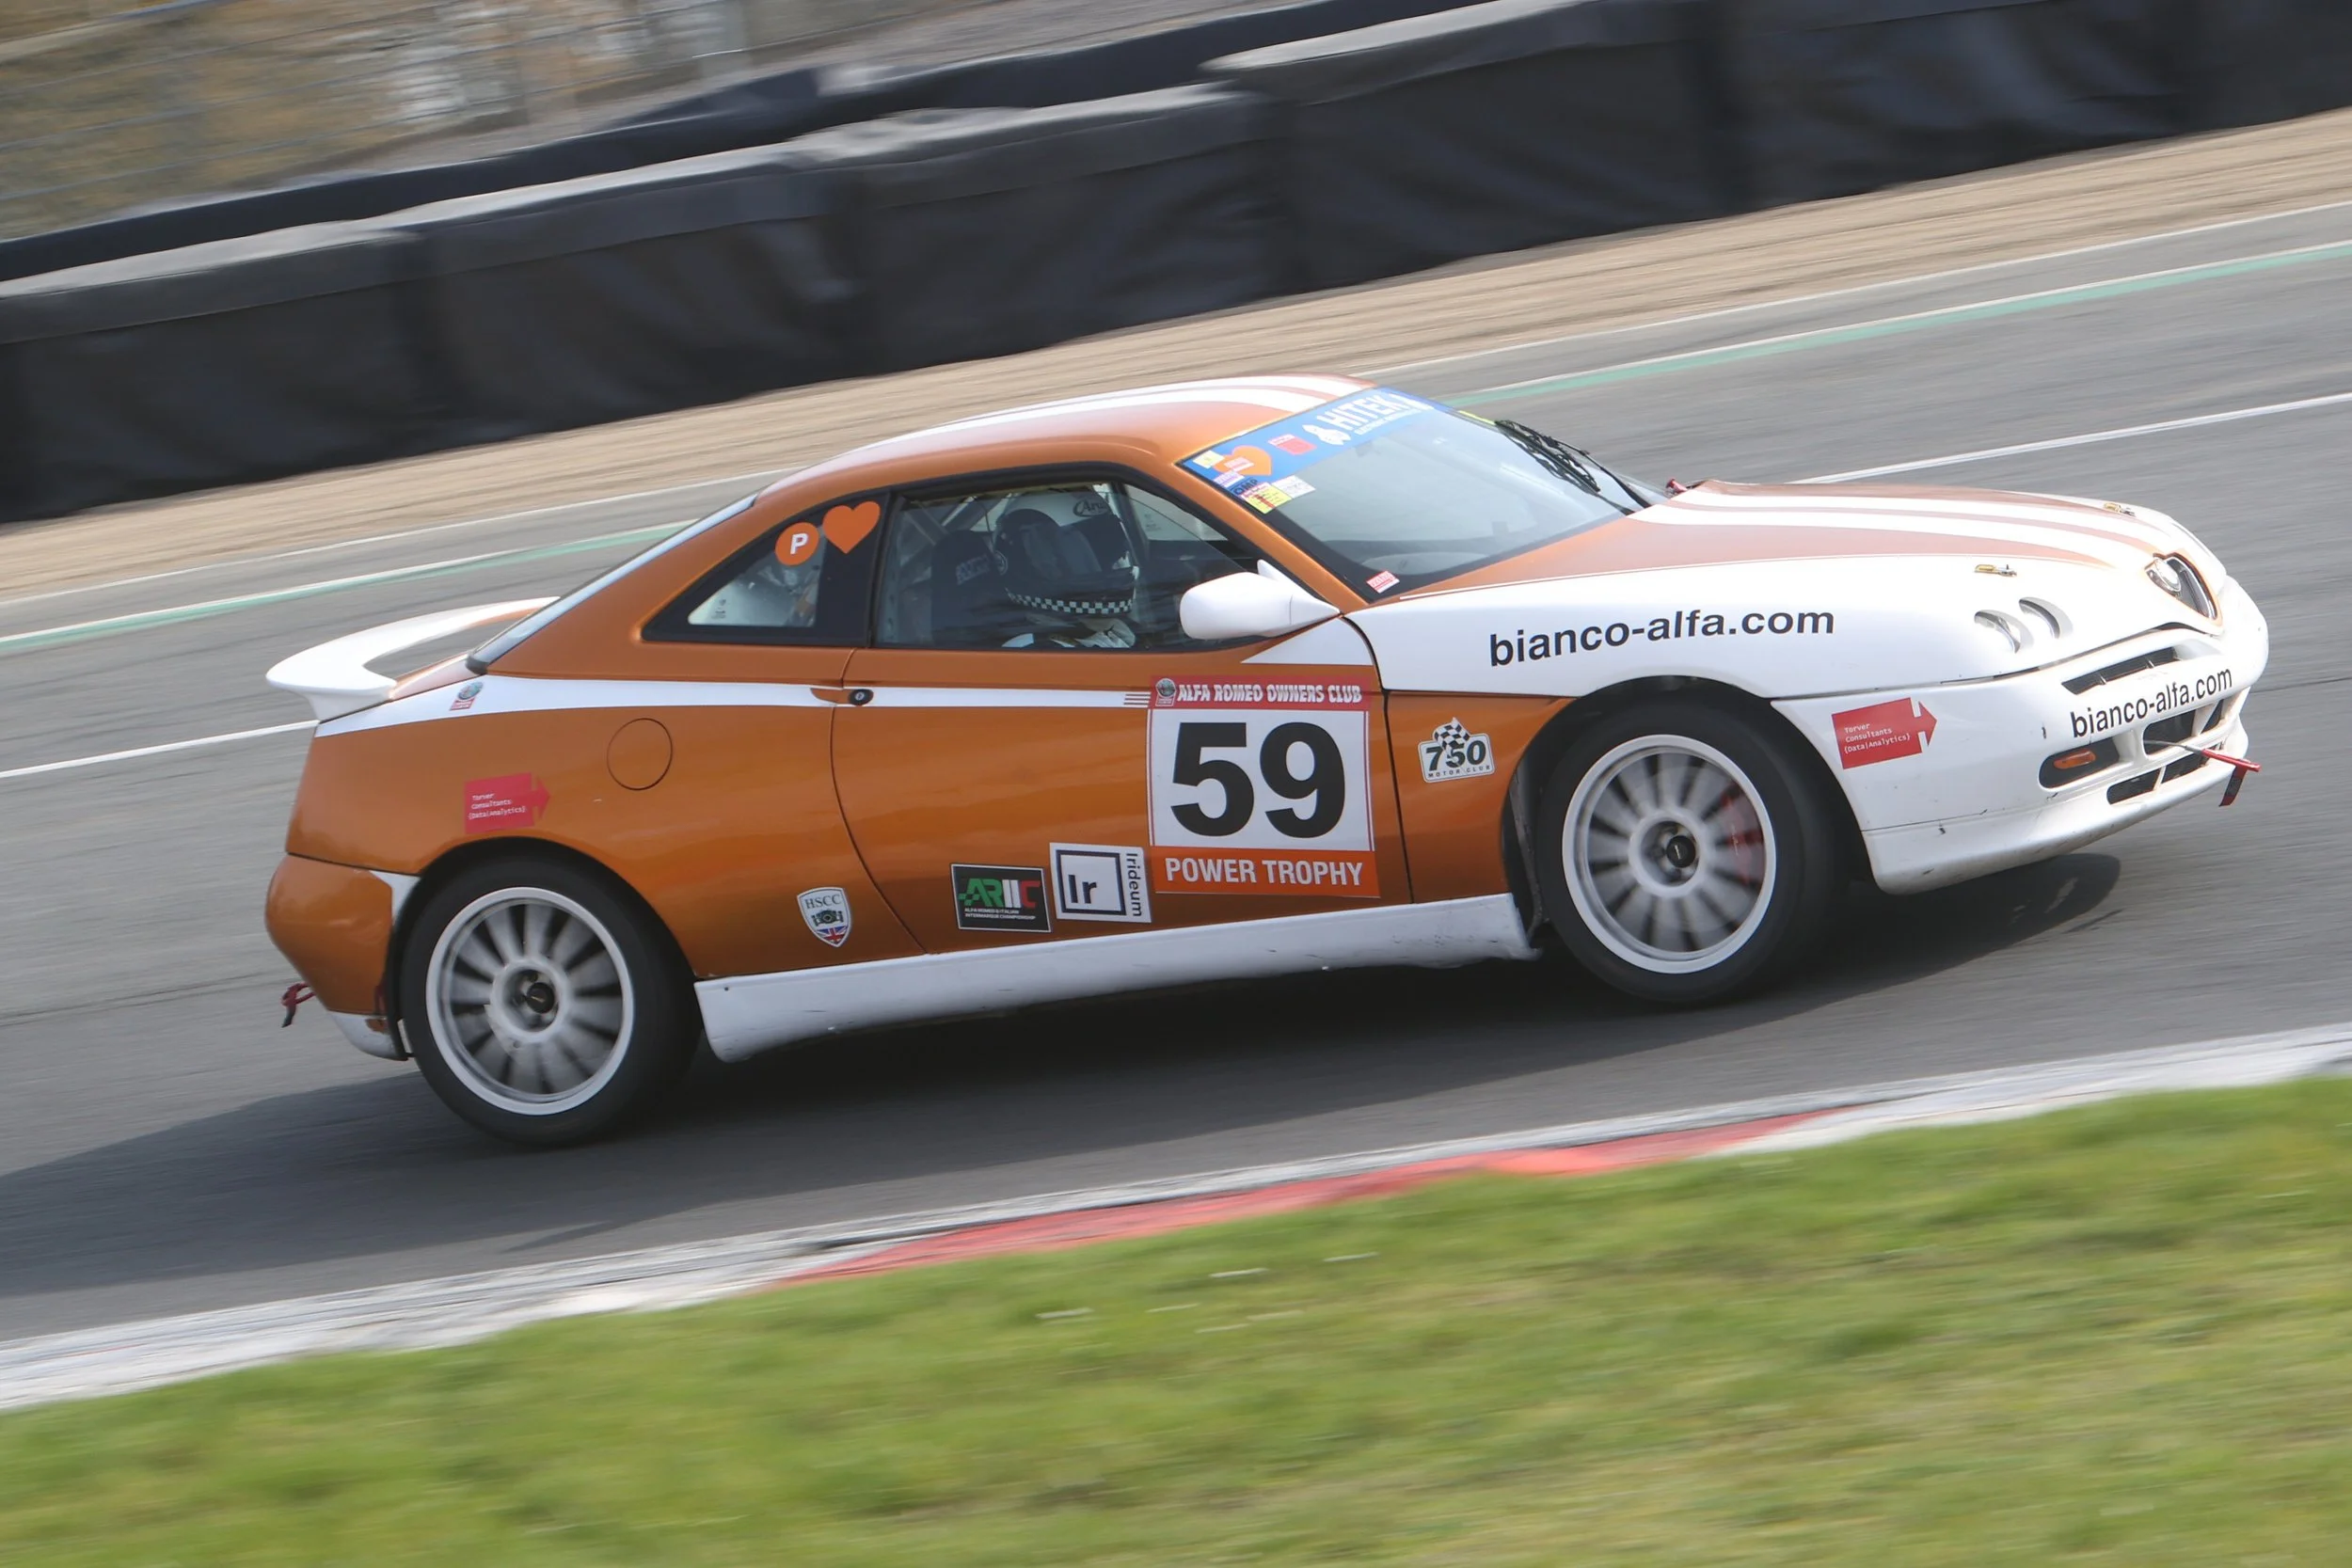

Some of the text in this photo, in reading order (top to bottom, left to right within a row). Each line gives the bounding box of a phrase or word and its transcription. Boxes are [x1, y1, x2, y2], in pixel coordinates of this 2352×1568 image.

[1316, 394, 1410, 431] HITEK
[790, 533, 808, 555] P
[1489, 610, 1835, 667] bianco-alfa.com
[1177, 684, 1211, 702] ALFA
[1214, 684, 1263, 702] ROMEO
[1266, 684, 1325, 703] OWNERS
[1327, 685, 1362, 704] CLUB
[2071, 668, 2233, 738] bianco-alfa.com
[1845, 722, 1870, 734] Torver
[1426, 739, 1486, 771] 750
[1170, 721, 1345, 838] 59
[1427, 765, 1490, 778] MOTOR CLUB
[1126, 852, 1142, 917] Irideum
[1166, 858, 1363, 886] POWER TROPHY
[804, 894, 842, 910] HSCC
[1068, 874, 1097, 904] Ir
